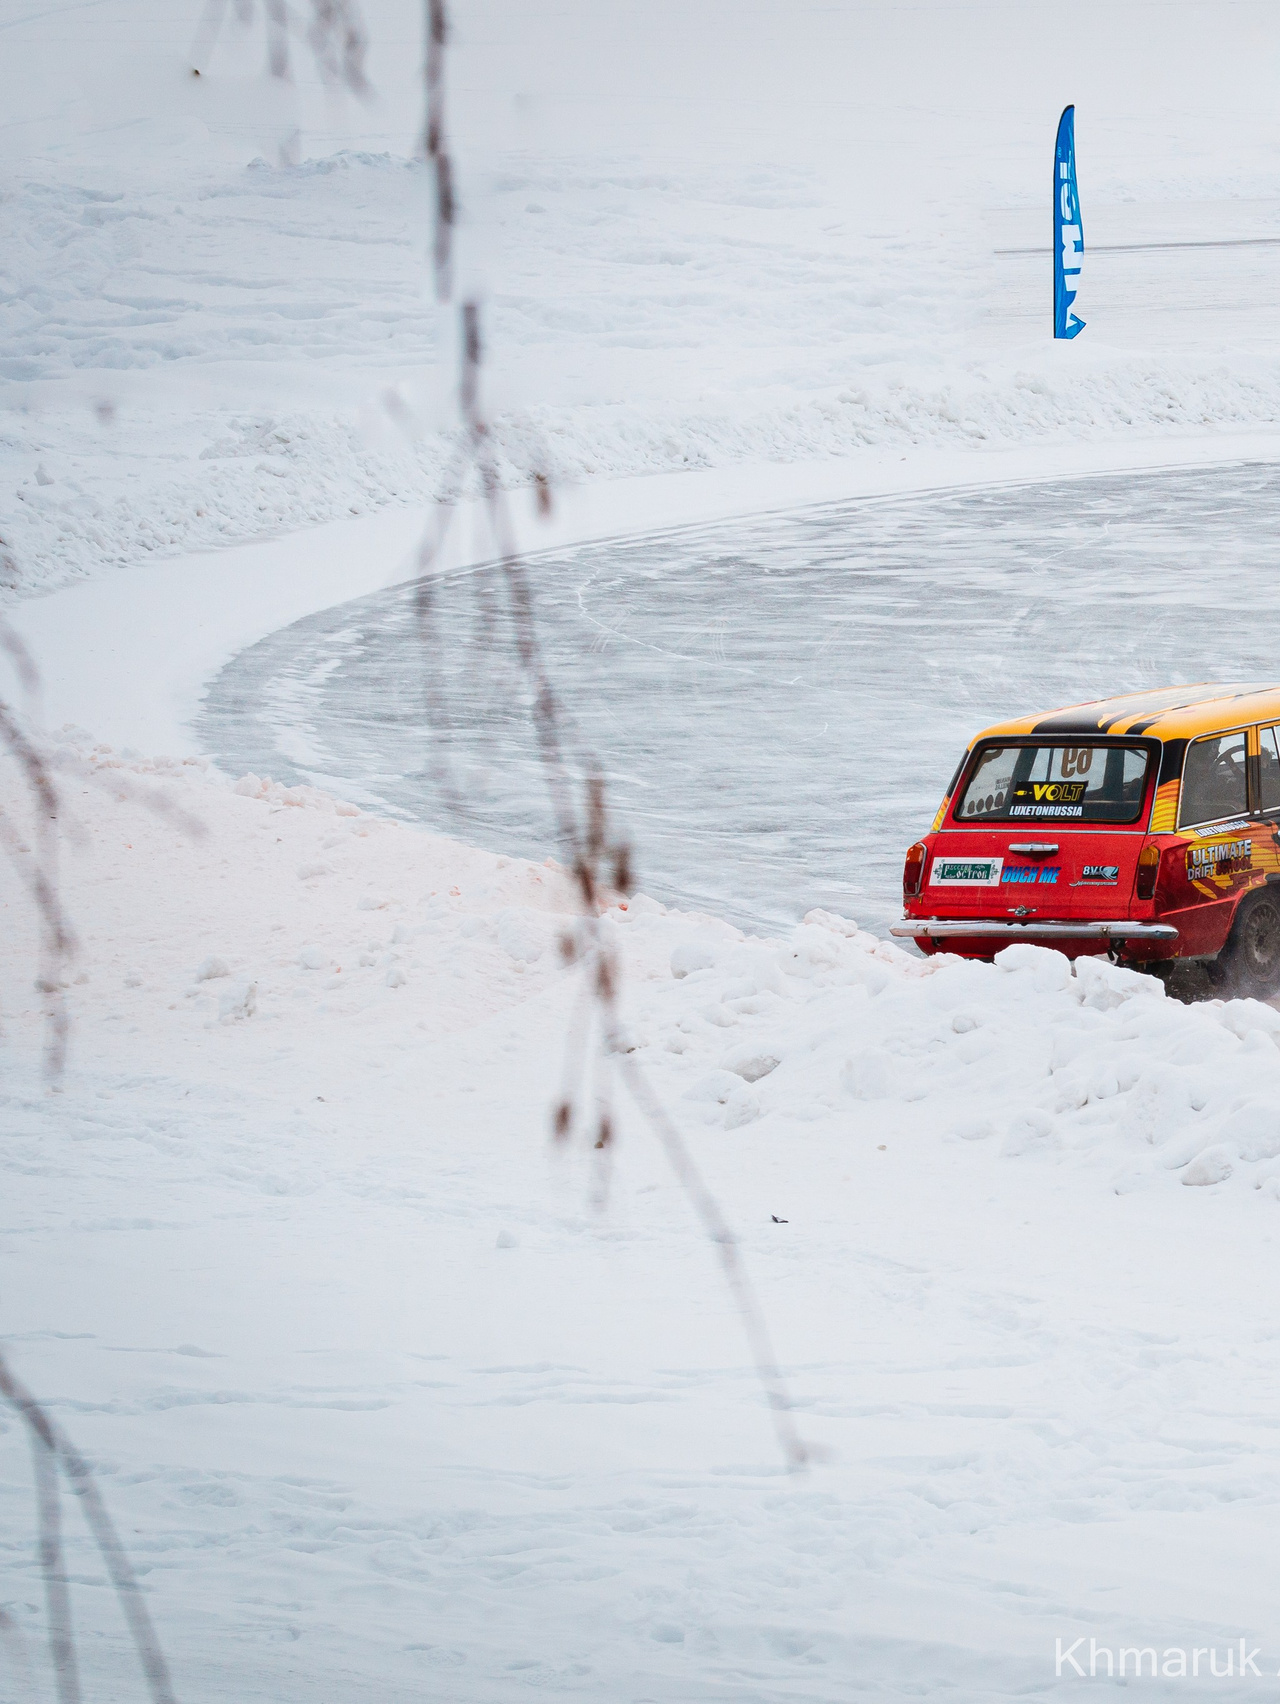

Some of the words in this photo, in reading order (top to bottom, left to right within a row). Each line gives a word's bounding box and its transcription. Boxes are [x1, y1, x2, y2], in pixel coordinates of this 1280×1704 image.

[1033, 784, 1084, 801] VOLT
[1009, 805, 1083, 817] LUXETONRUSSIA
[1192, 839, 1252, 866] ULTIMATE
[1038, 866, 1061, 884] ME
[1187, 863, 1215, 881] DRIFT
